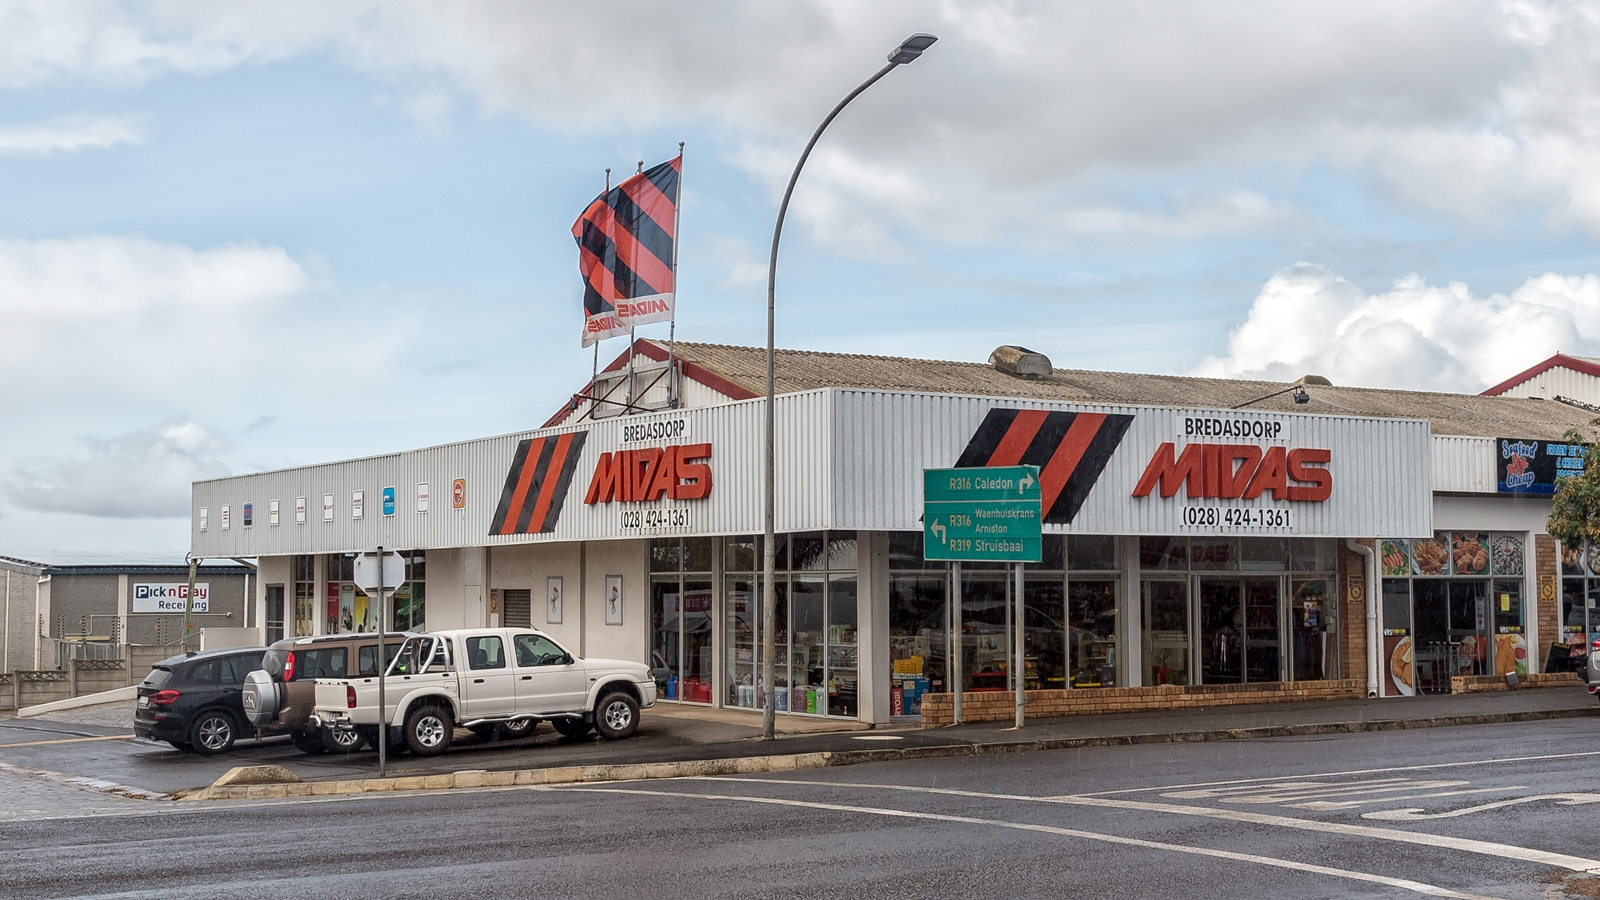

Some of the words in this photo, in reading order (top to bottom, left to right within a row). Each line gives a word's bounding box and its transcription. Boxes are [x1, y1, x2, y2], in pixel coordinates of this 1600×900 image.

[624, 419, 685, 442] BREDASDORP
[1185, 418, 1281, 438] BREDASDORP
[1502, 440, 1538, 459] Seafood
[1546, 443, 1567, 456] FROZEN
[584, 443, 712, 504] MIDAS
[1132, 442, 1332, 502] MIDAS
[1506, 471, 1535, 488] Cheap
[949, 478, 971, 489] R316
[975, 477, 1013, 489] Caledon
[620, 510, 643, 528] (028)
[646, 509, 689, 527] 424-1361
[949, 515, 972, 527] R316
[975, 508, 1034, 518] Waenhuiskrans
[1183, 506, 1220, 526] (028)
[1225, 508, 1290, 527] 424-1361
[975, 523, 1008, 533] Arniston
[949, 539, 971, 551] R319
[975, 540, 1023, 552] Struisbaai
[1167, 544, 1229, 563] MDAS
[136, 585, 166, 598] Pick
[168, 588, 176, 597] n
[159, 600, 207, 611] Receiing
